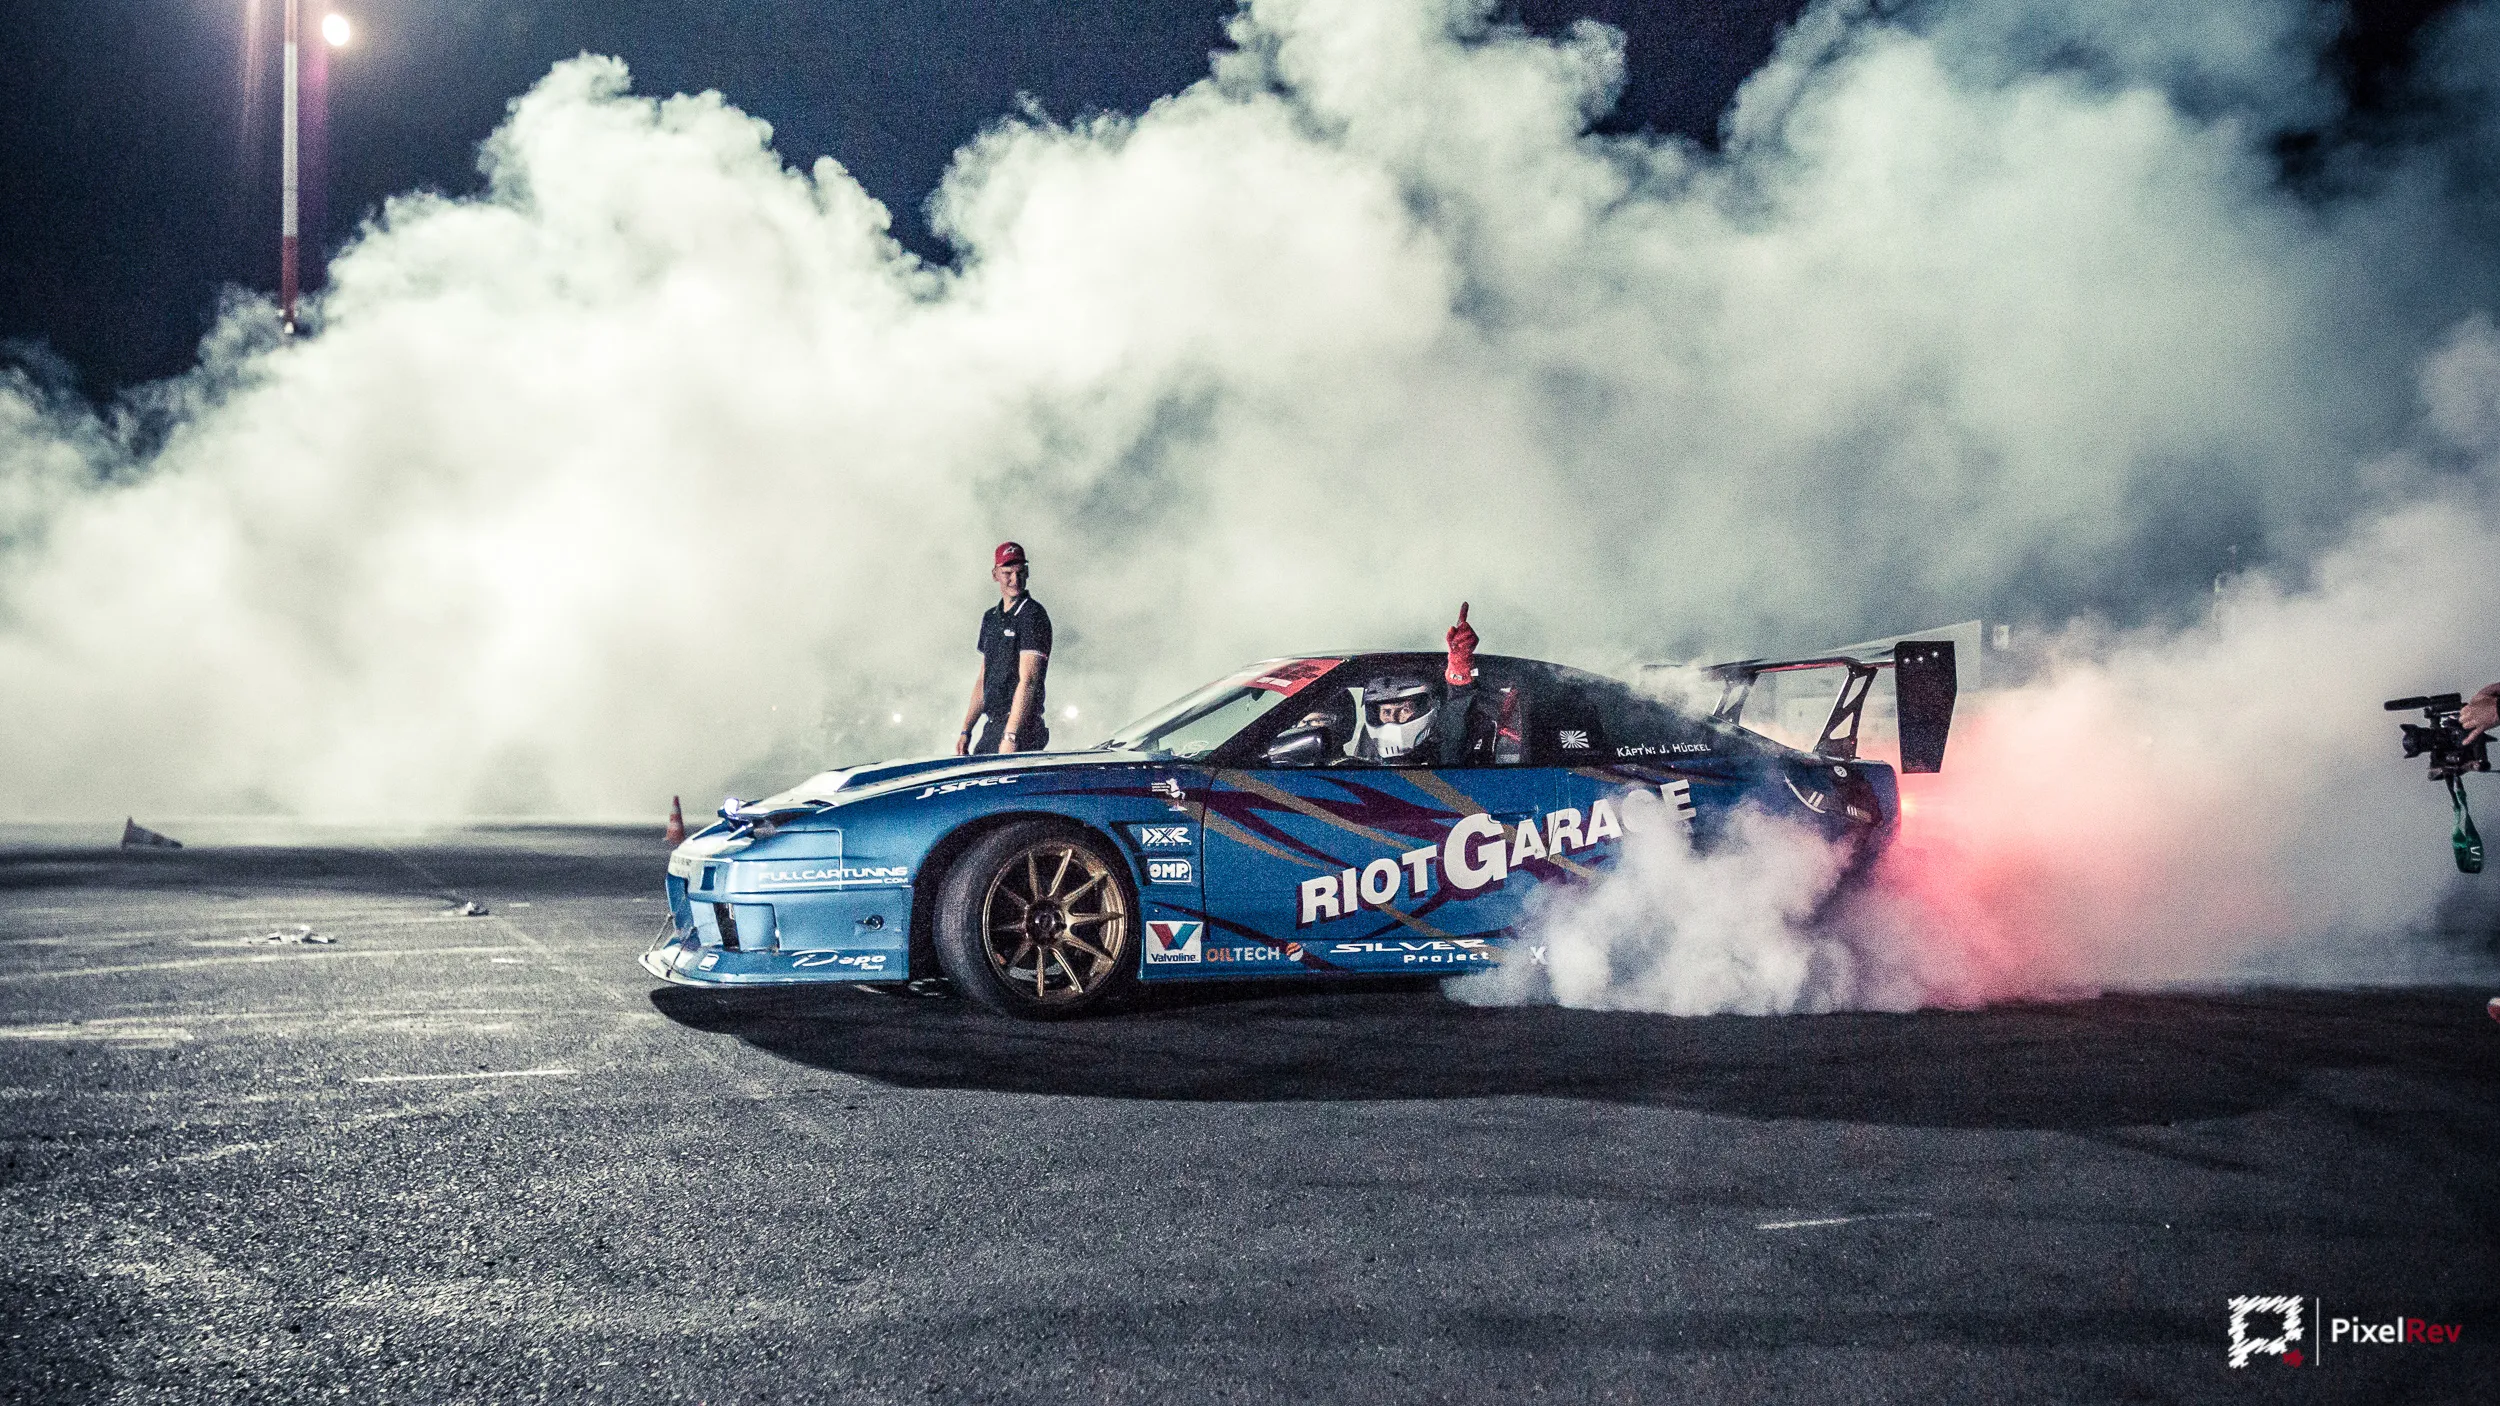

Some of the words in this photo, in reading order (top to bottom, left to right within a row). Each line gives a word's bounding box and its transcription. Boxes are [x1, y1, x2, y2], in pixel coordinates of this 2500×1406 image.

[1660, 744, 1670, 754] J.
[1330, 939, 1488, 953] SILVER
[1151, 953, 1196, 963] Valvoline
[1206, 946, 1280, 963] OILTECH
[1403, 951, 1490, 964] Project
